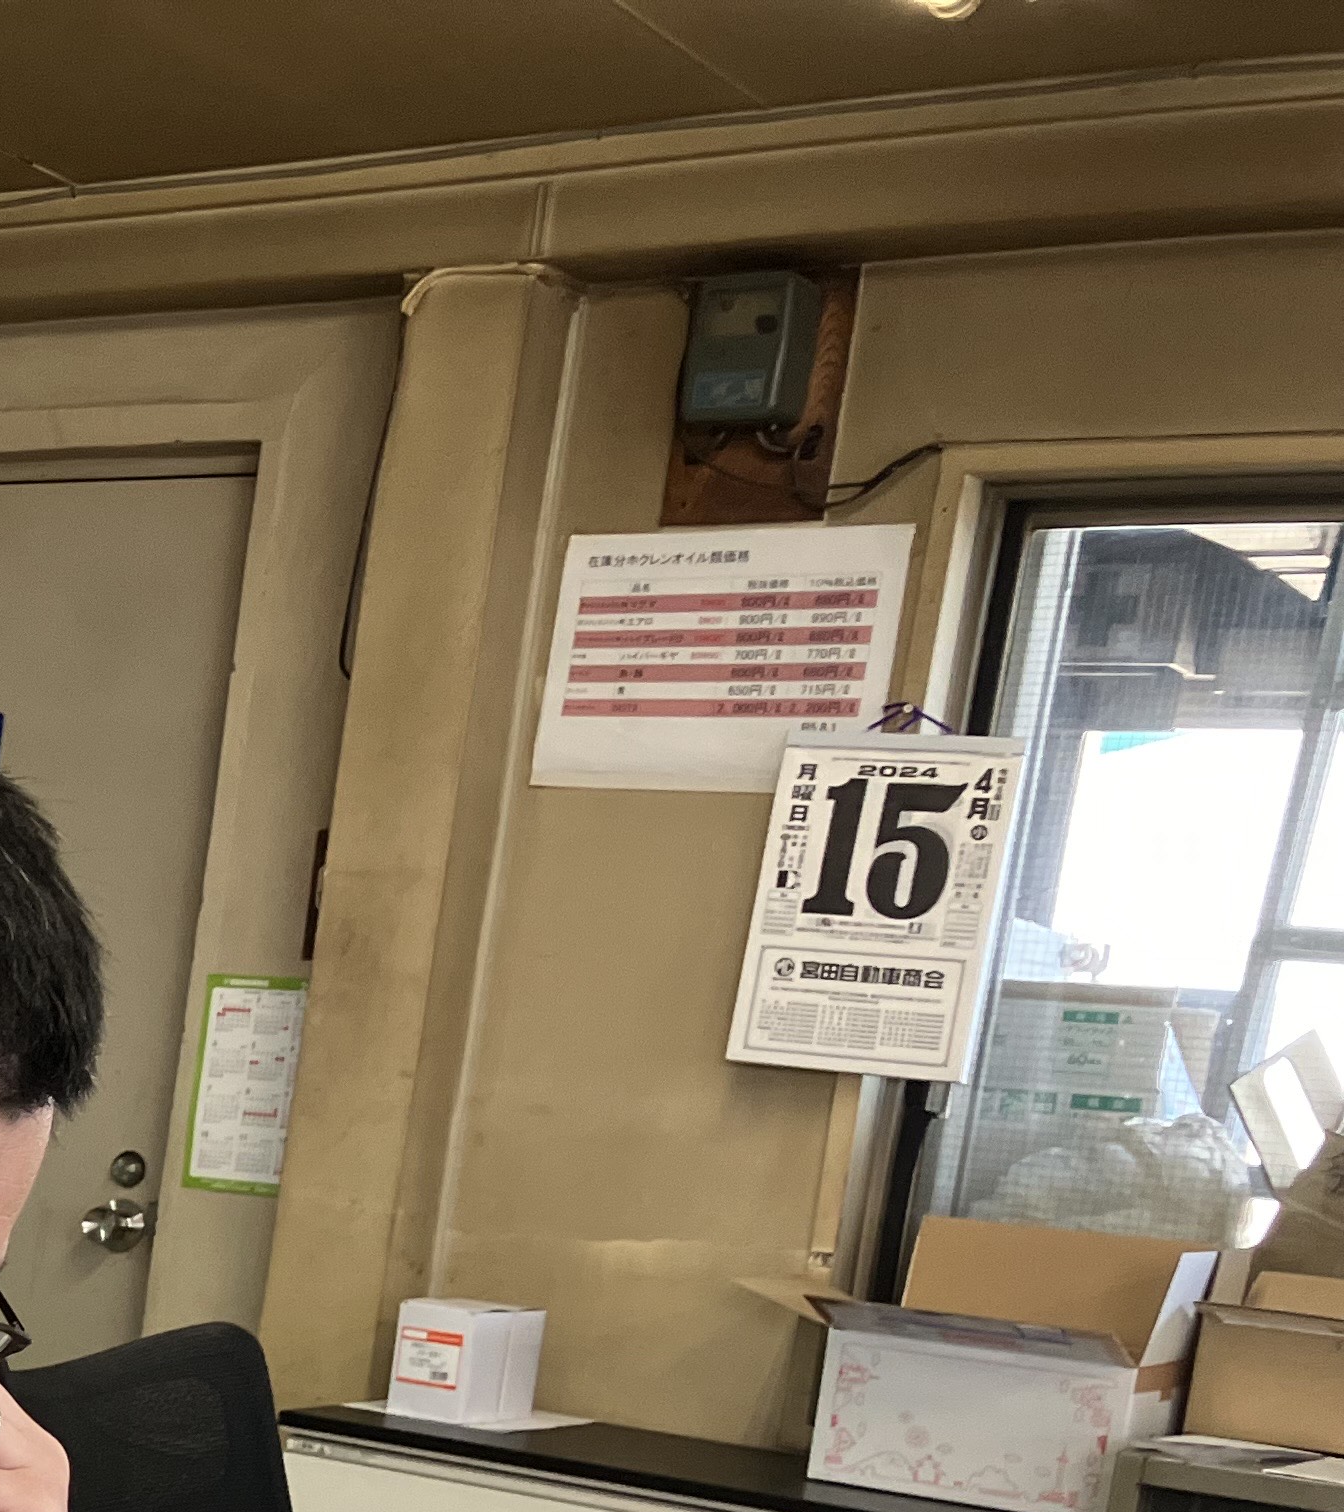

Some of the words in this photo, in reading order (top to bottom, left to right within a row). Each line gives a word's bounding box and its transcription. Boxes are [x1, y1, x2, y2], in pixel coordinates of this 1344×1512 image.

[789, 763, 817, 822] 月曜日
[857, 764, 939, 778] 2024
[967, 767, 994, 820] 4月
[800, 777, 969, 920] 15
[800, 960, 945, 990] 宮田自動車商会
